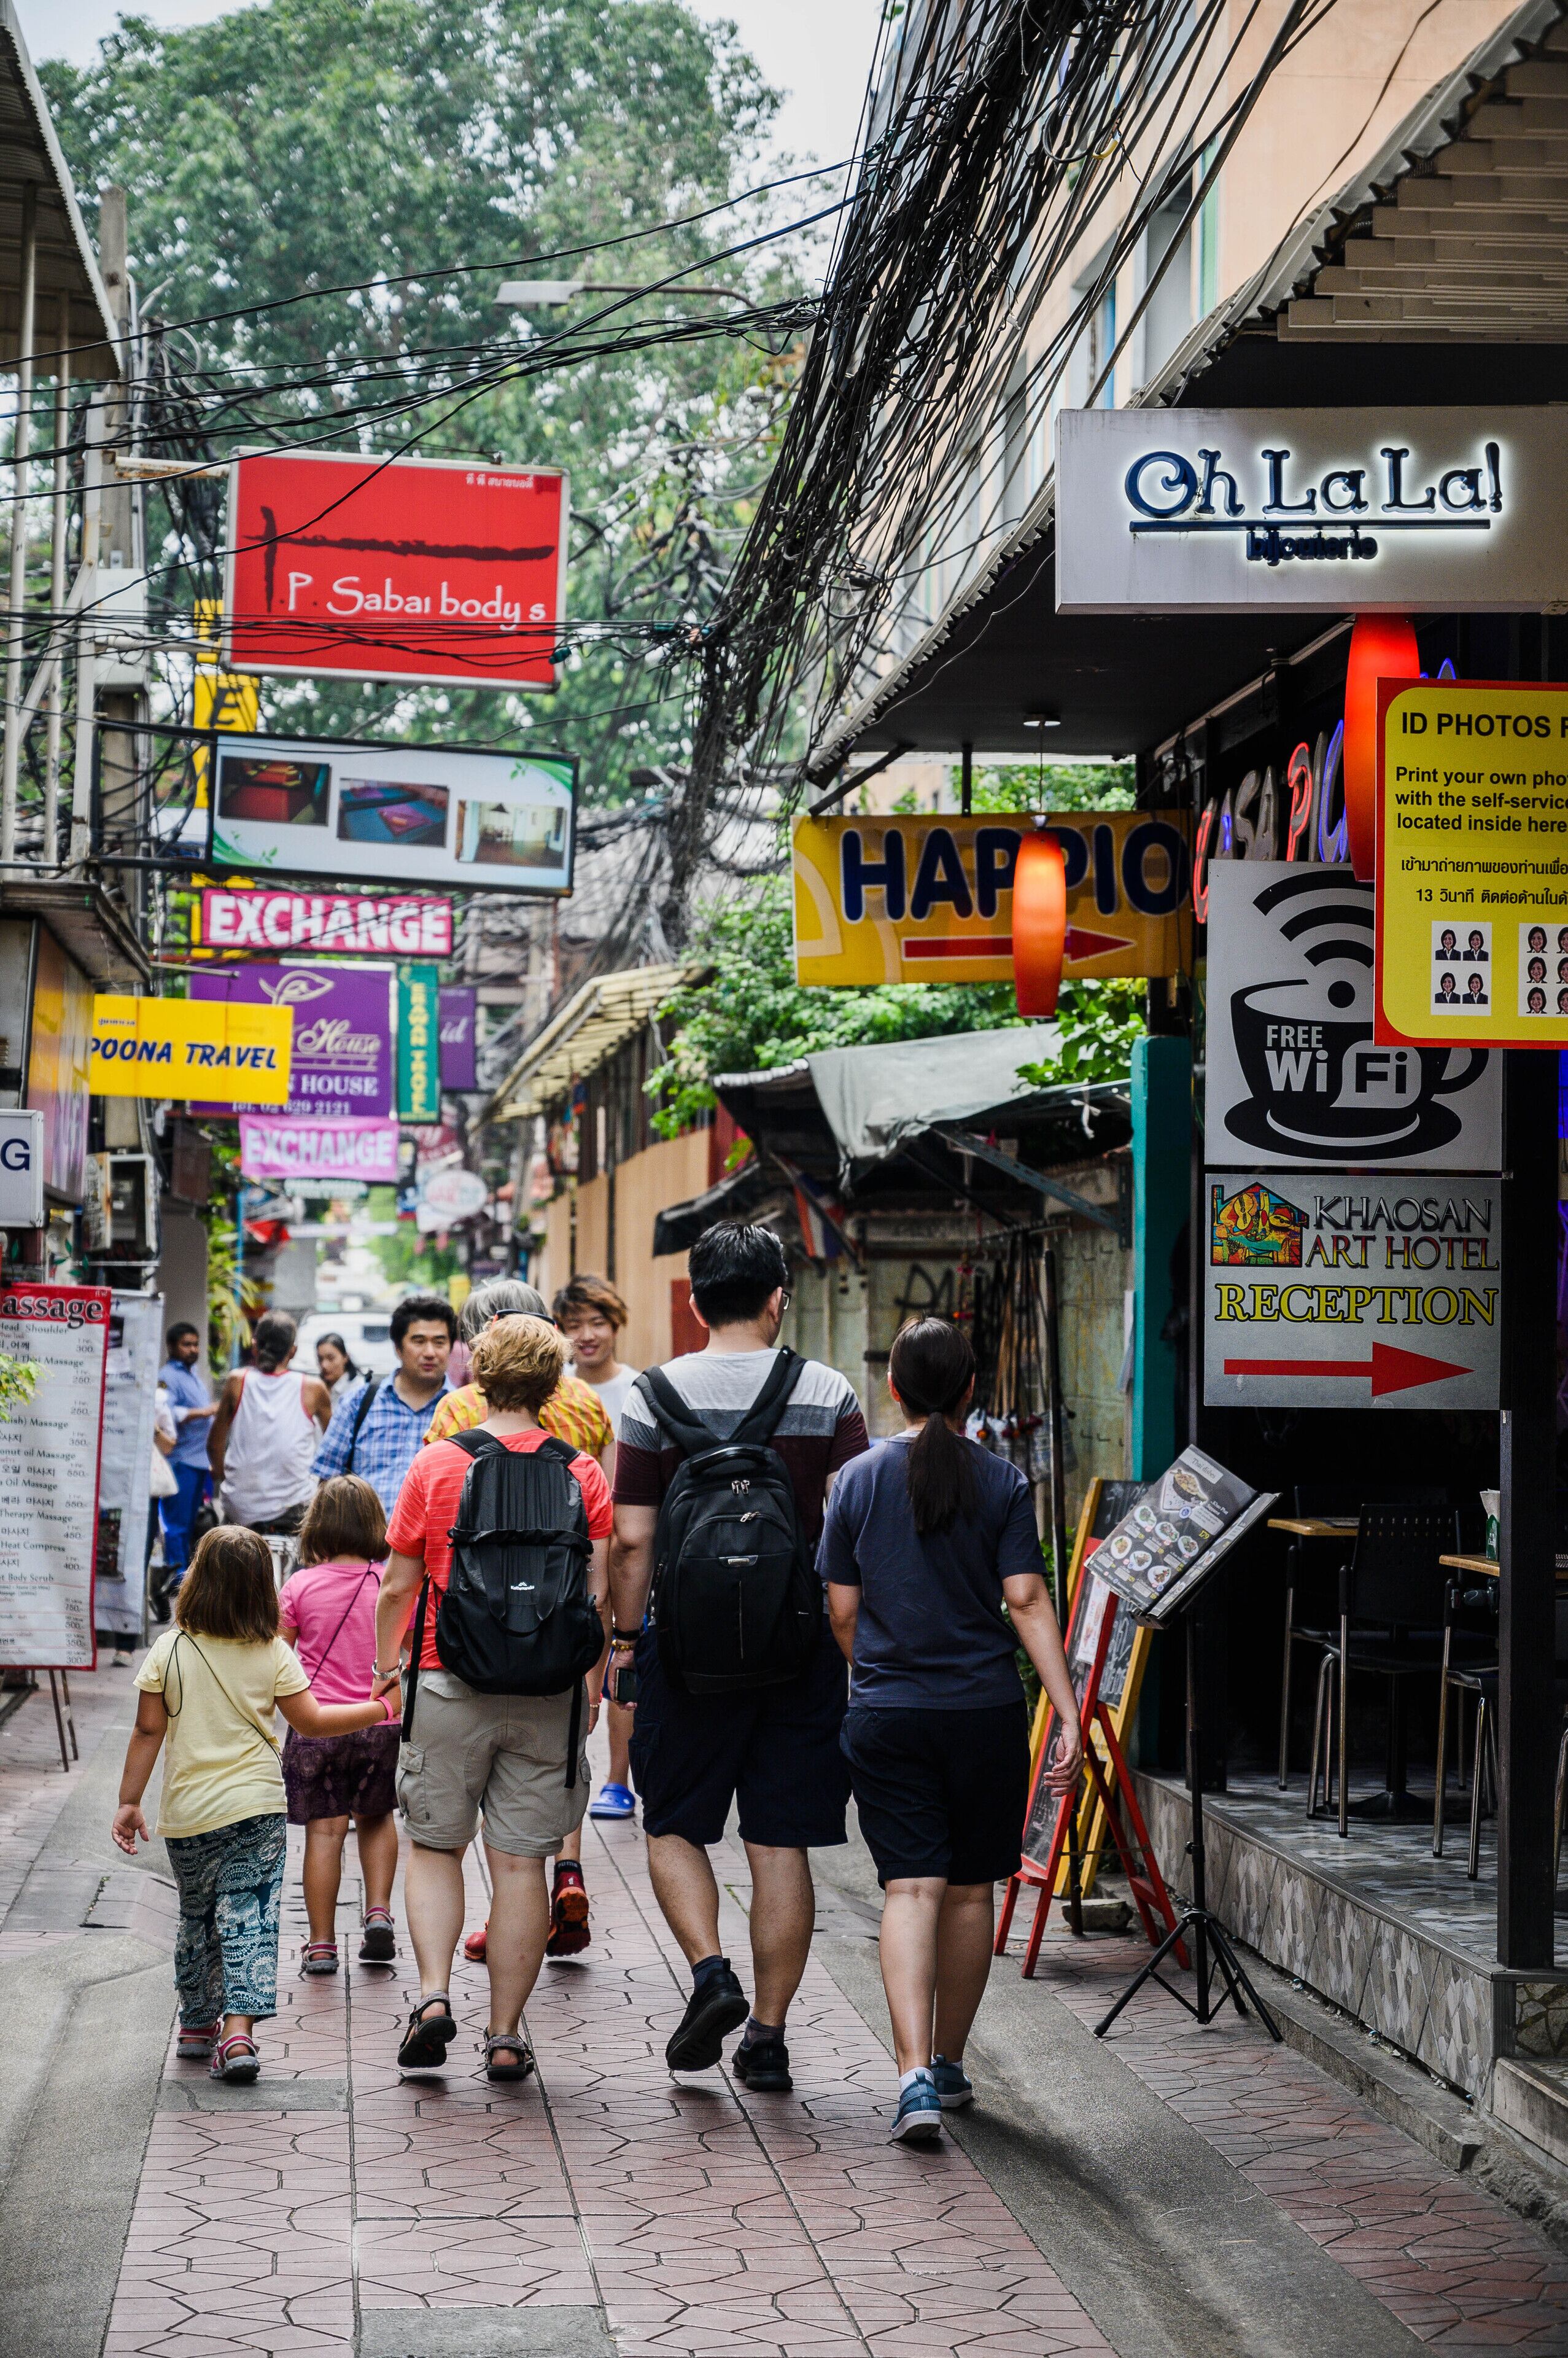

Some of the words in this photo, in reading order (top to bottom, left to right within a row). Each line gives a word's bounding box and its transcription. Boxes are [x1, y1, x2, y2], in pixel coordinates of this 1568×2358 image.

[1124, 448, 1246, 519] Oh
[1261, 448, 1368, 516] La
[1380, 442, 1502, 514] La!
[1246, 529, 1378, 567] bijouterie
[1402, 712, 1427, 734] ID
[1437, 713, 1551, 739] PHOTOS
[1396, 766, 1438, 782] Print
[1443, 771, 1485, 787] your
[1489, 772, 1526, 786] own
[1395, 790, 1432, 806] with
[1438, 792, 1466, 807] the
[1397, 812, 1462, 831] located
[1468, 815, 1522, 832] inside
[1416, 889, 1433, 903] 13
[1440, 887, 1474, 903] วินาที
[209, 894, 451, 952] EXCHANGE
[1267, 1025, 1323, 1048] FREE
[91, 1038, 172, 1063] POONA
[185, 1043, 276, 1068] TRAVEL
[301, 1074, 379, 1097] HOUSE
[1, 1138, 30, 1171] G
[246, 1130, 395, 1166] EXCHANGE
[1313, 1196, 1491, 1233] KHAOSAN
[1305, 1234, 1376, 1269] ART
[1385, 1235, 1499, 1270] HOTEL
[1214, 1282, 1499, 1326] RECEPTION
[26, 1325, 69, 1334] Shoulder
[44, 1356, 84, 1368] Massage
[30, 1417, 69, 1430] Massage
[37, 1450, 76, 1461] Massage
[6, 1477, 18, 1487] Oil
[21, 1479, 58, 1492] Massage
[37, 1511, 72, 1523] Massage
[23, 1541, 66, 1553] Compress
[9, 1573, 27, 1582] Body
[30, 1573, 53, 1582] Scrub
